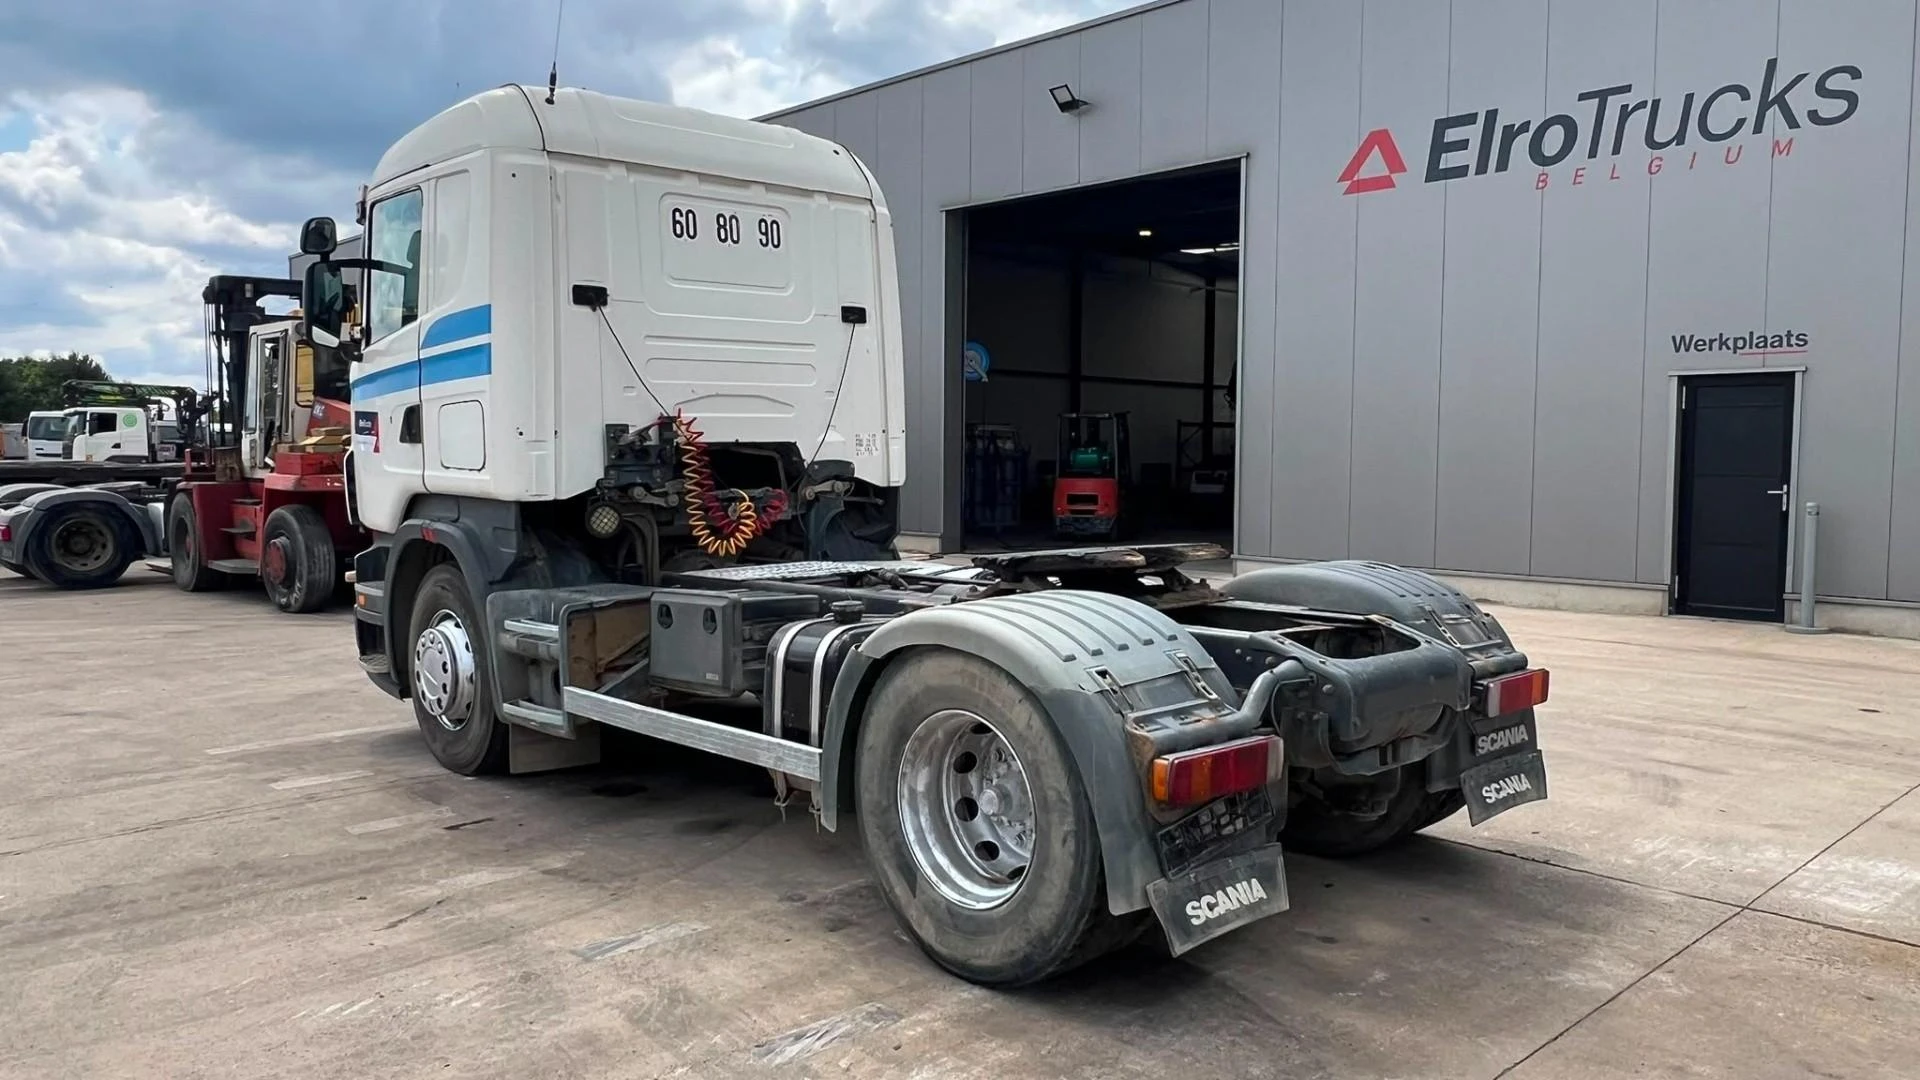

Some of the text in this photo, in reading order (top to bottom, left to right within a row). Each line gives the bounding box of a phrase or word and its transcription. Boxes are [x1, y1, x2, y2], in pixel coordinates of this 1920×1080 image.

[1423, 57, 1862, 184] ElroTrucks
[1535, 137, 1795, 191] BELGIUM
[671, 208, 782, 249] 60 80 90
[1671, 329, 1809, 355] Werkplaats
[1477, 724, 1529, 755] SCANIA
[1481, 773, 1532, 804] SCANIA
[1185, 878, 1268, 926] SCANIA
